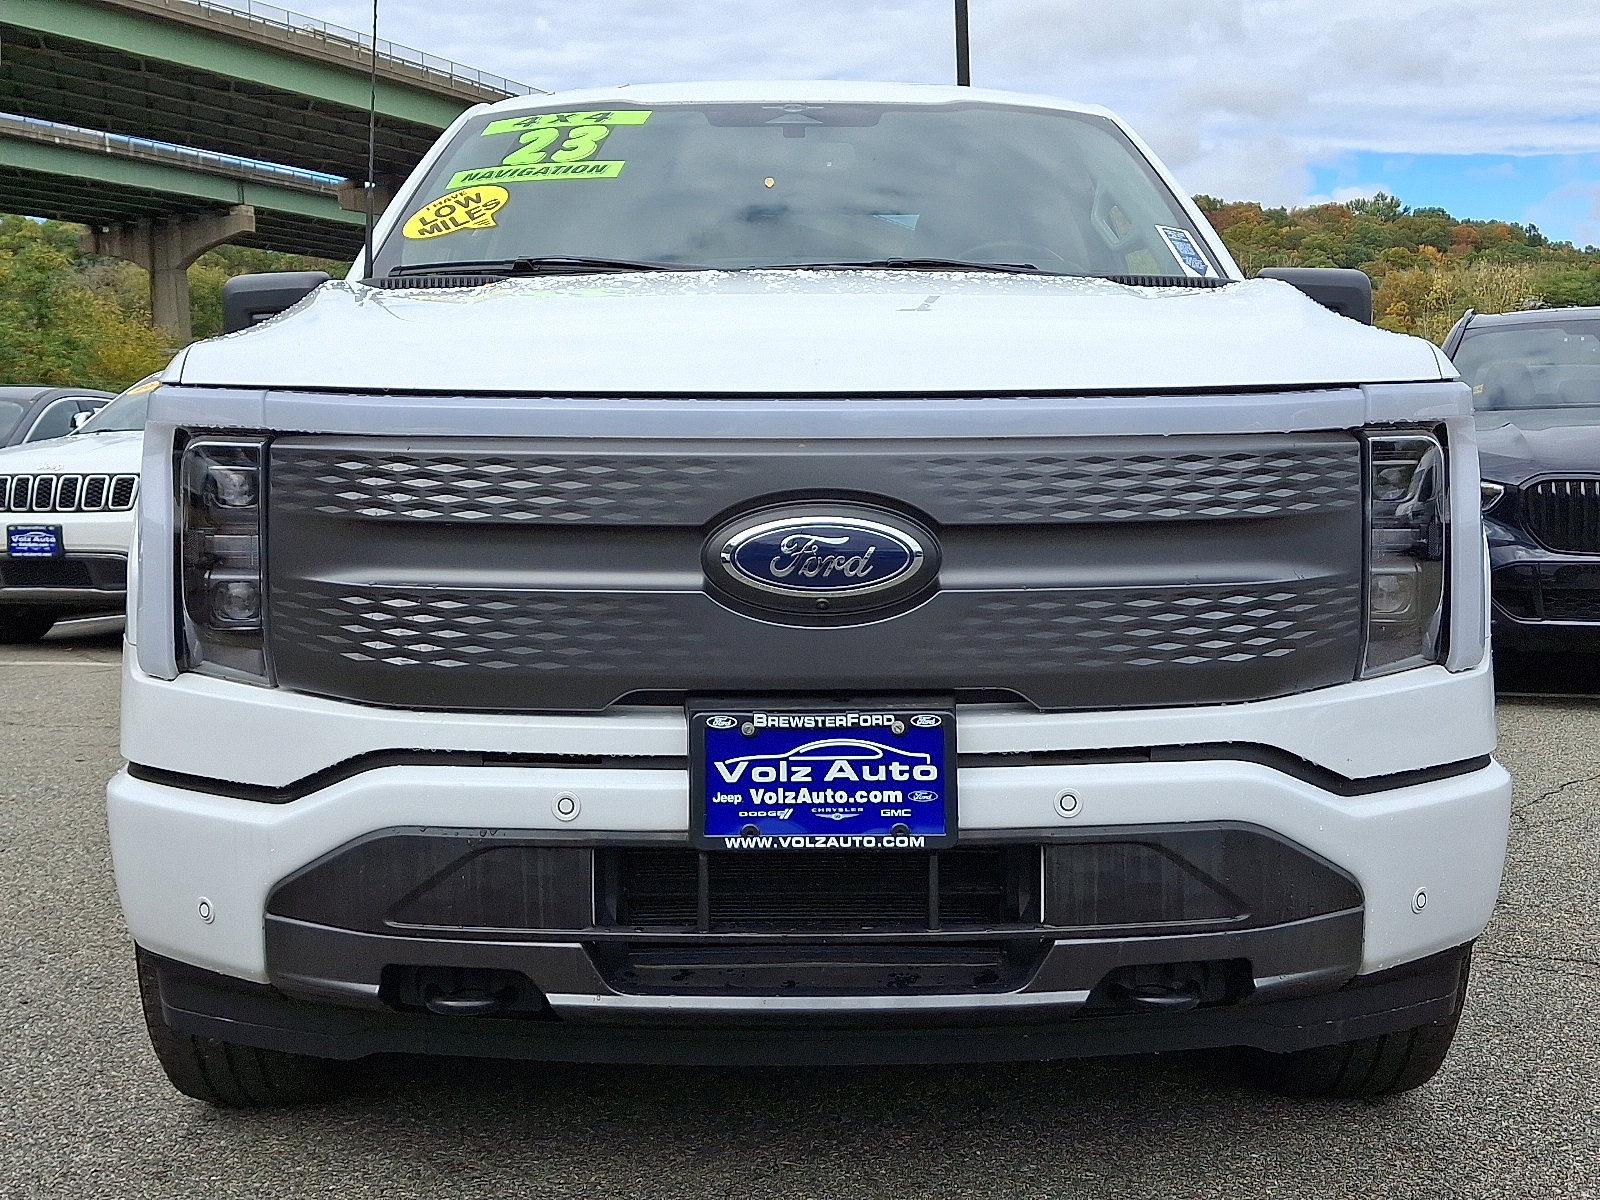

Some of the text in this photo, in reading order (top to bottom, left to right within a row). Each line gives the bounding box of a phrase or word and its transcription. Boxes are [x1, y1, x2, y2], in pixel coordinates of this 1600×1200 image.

[502, 124, 610, 166] 23
[459, 164, 608, 183] NAVIGATION
[433, 190, 468, 208] HAVE
[417, 198, 501, 236] MILES
[419, 192, 482, 226] LOW
[32, 535, 56, 543] Auto
[770, 533, 877, 578] Ford
[713, 759, 938, 783] Volz Auto
[712, 791, 742, 805] Jeep
[749, 787, 903, 804] VolzAuto.com
[880, 808, 912, 817] GMC
[724, 836, 925, 849] WWW.VOLZAUTO.COM
